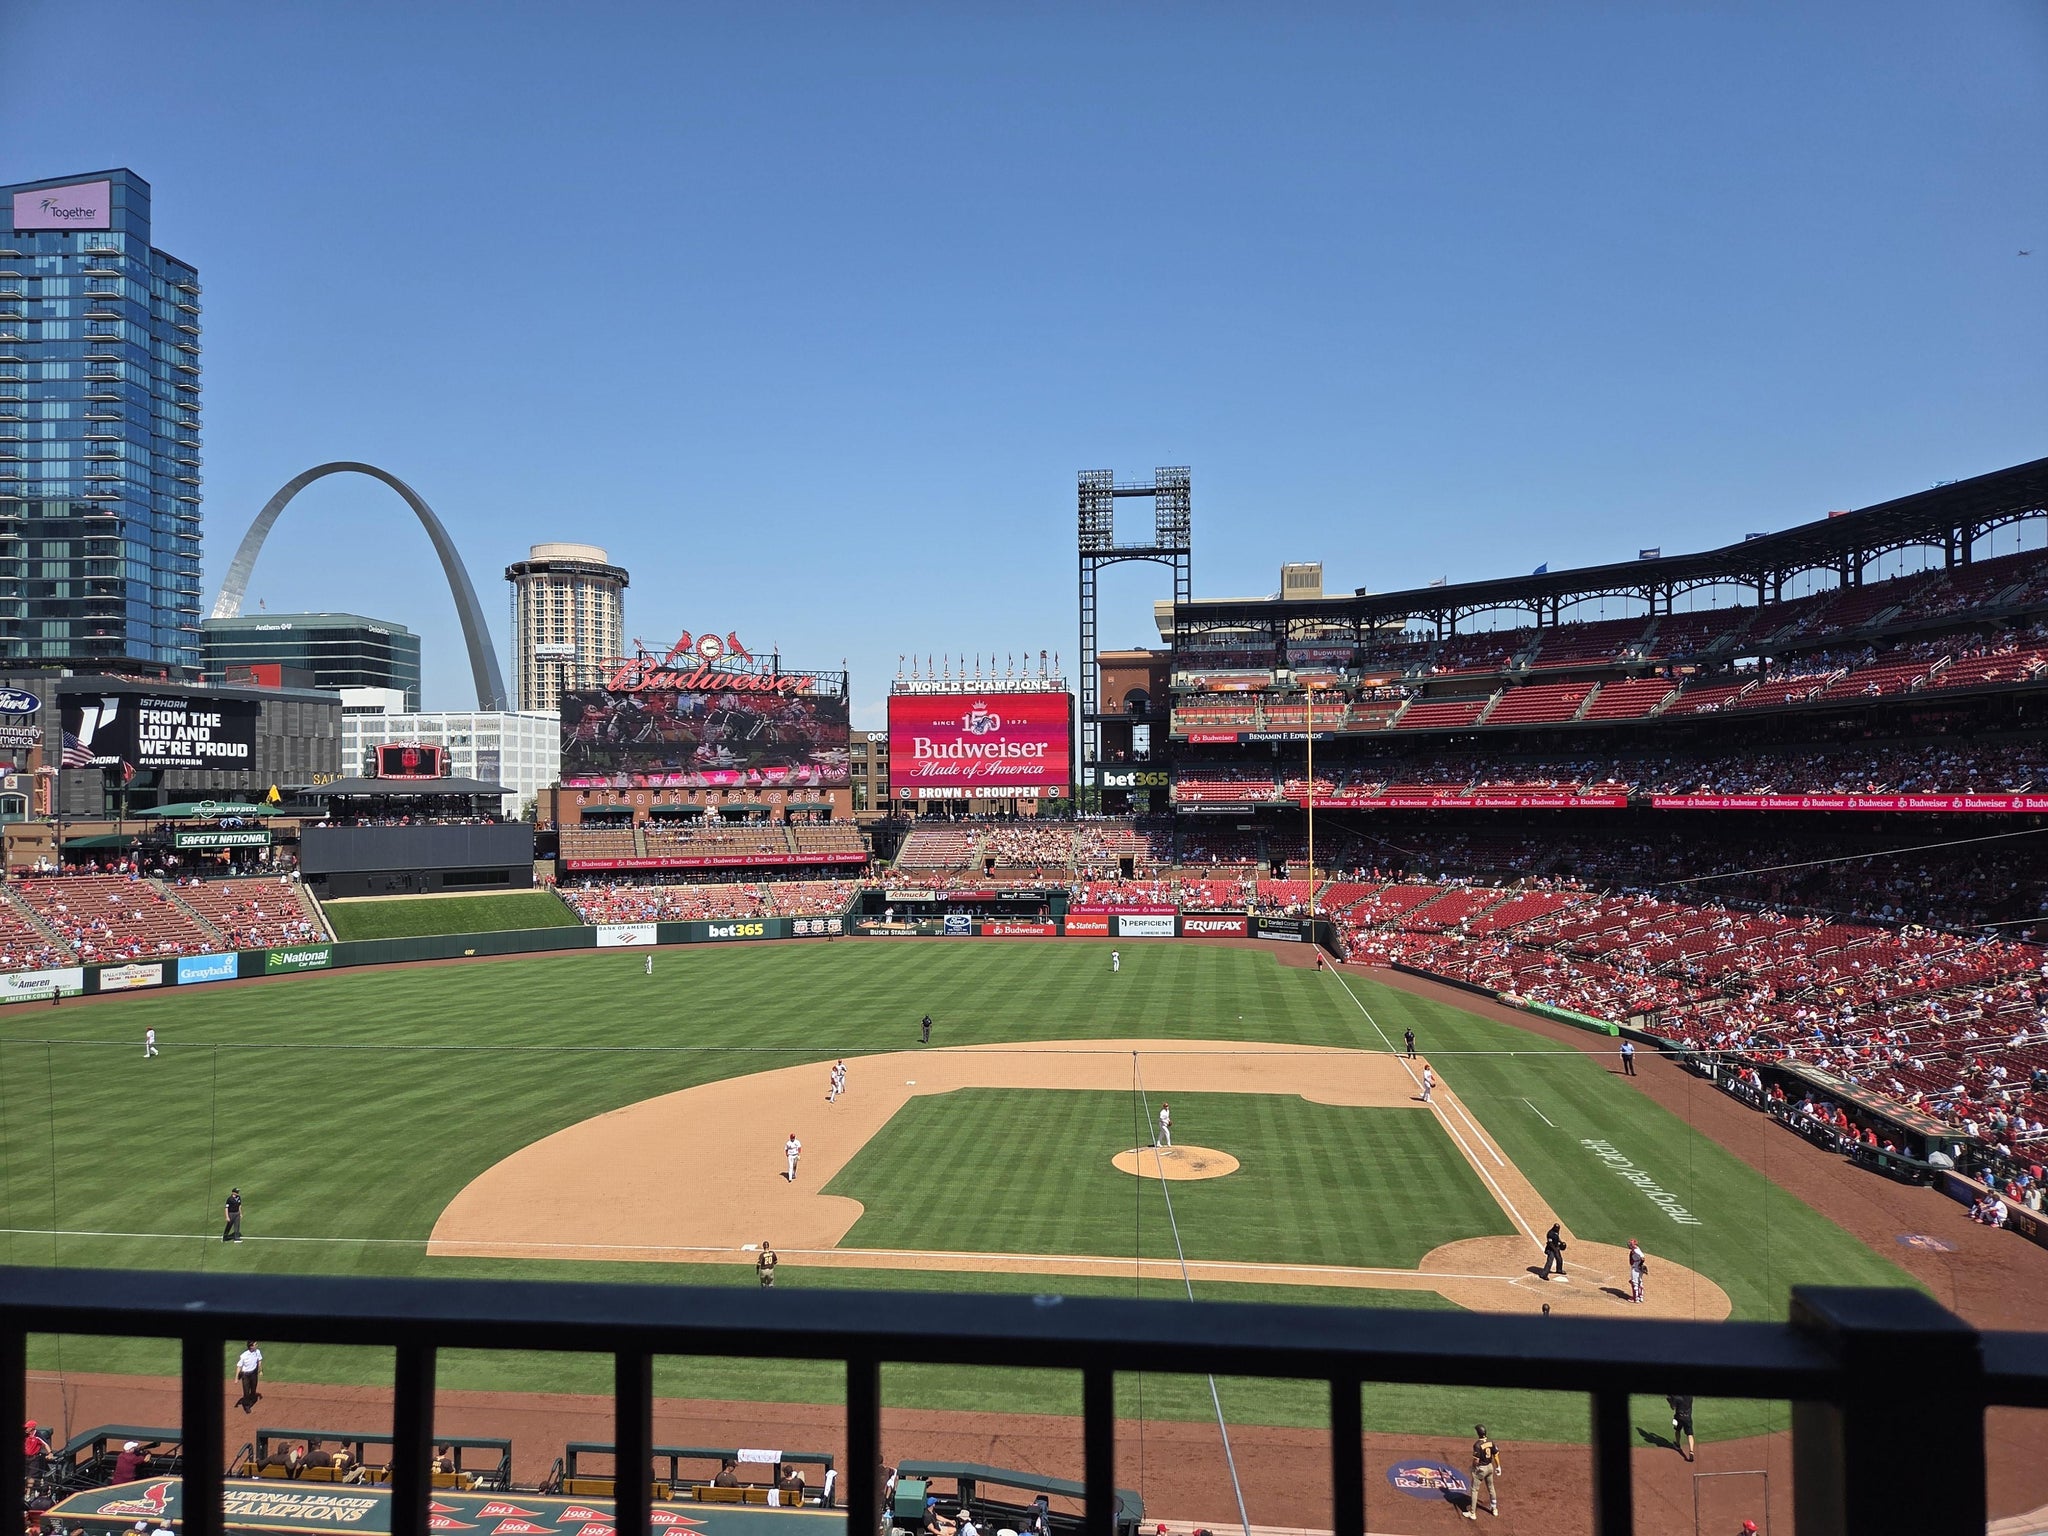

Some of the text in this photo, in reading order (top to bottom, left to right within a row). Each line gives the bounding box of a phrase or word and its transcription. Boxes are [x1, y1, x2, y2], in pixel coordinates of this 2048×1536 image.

[50, 206, 97, 220] Together
[599, 657, 816, 692] Budweiser
[909, 680, 1051, 692] WORLD CHAMPIONS
[139, 709, 221, 727] FROM THE
[0, 726, 41, 739] mmunity
[139, 725, 210, 741] LOU AND
[1290, 732, 1322, 740] EDWADS
[0, 736, 33, 745] merica
[195, 742, 248, 757] PROUD
[912, 737, 1049, 759] Budweiser
[910, 760, 1046, 779] Made of America
[1104, 772, 1168, 786] bet365
[919, 787, 1039, 798] BROWN & CROUPPEN
[609, 794, 616, 805] 2
[623, 794, 631, 805] 6
[637, 794, 644, 805] 9
[652, 794, 662, 805] 10
[669, 794, 681, 805] 14
[688, 794, 699, 805] 17
[706, 794, 719, 804] 20
[768, 793, 781, 804] 42
[788, 793, 801, 804] 45
[1769, 799, 1799, 807] Budweiser
[1812, 799, 1844, 807] Budweiser
[1858, 799, 1893, 807] Budweiser
[1909, 799, 1948, 807] Budweiser
[1965, 799, 2007, 808] Budweiser
[181, 834, 266, 845] SAFETY NATIONAL
[708, 923, 764, 937] bet365
[1004, 926, 1045, 934] Budweiser
[1184, 920, 1241, 933] EQUIFAX
[283, 949, 328, 964] National
[18, 979, 50, 989] Ameren
[5, 990, 75, 1002] AMEREN.COM/RATES
[1485, 1447, 1491, 1458] 9
[335, 1458, 341, 1468] 2
[299, 1494, 379, 1508] LEAGUE
[222, 1501, 368, 1521] HAMPIONS
[484, 1506, 513, 1514] 1943
[564, 1510, 594, 1519] 1985
[500, 1523, 530, 1532] 1968
[582, 1527, 613, 1536] 1987
